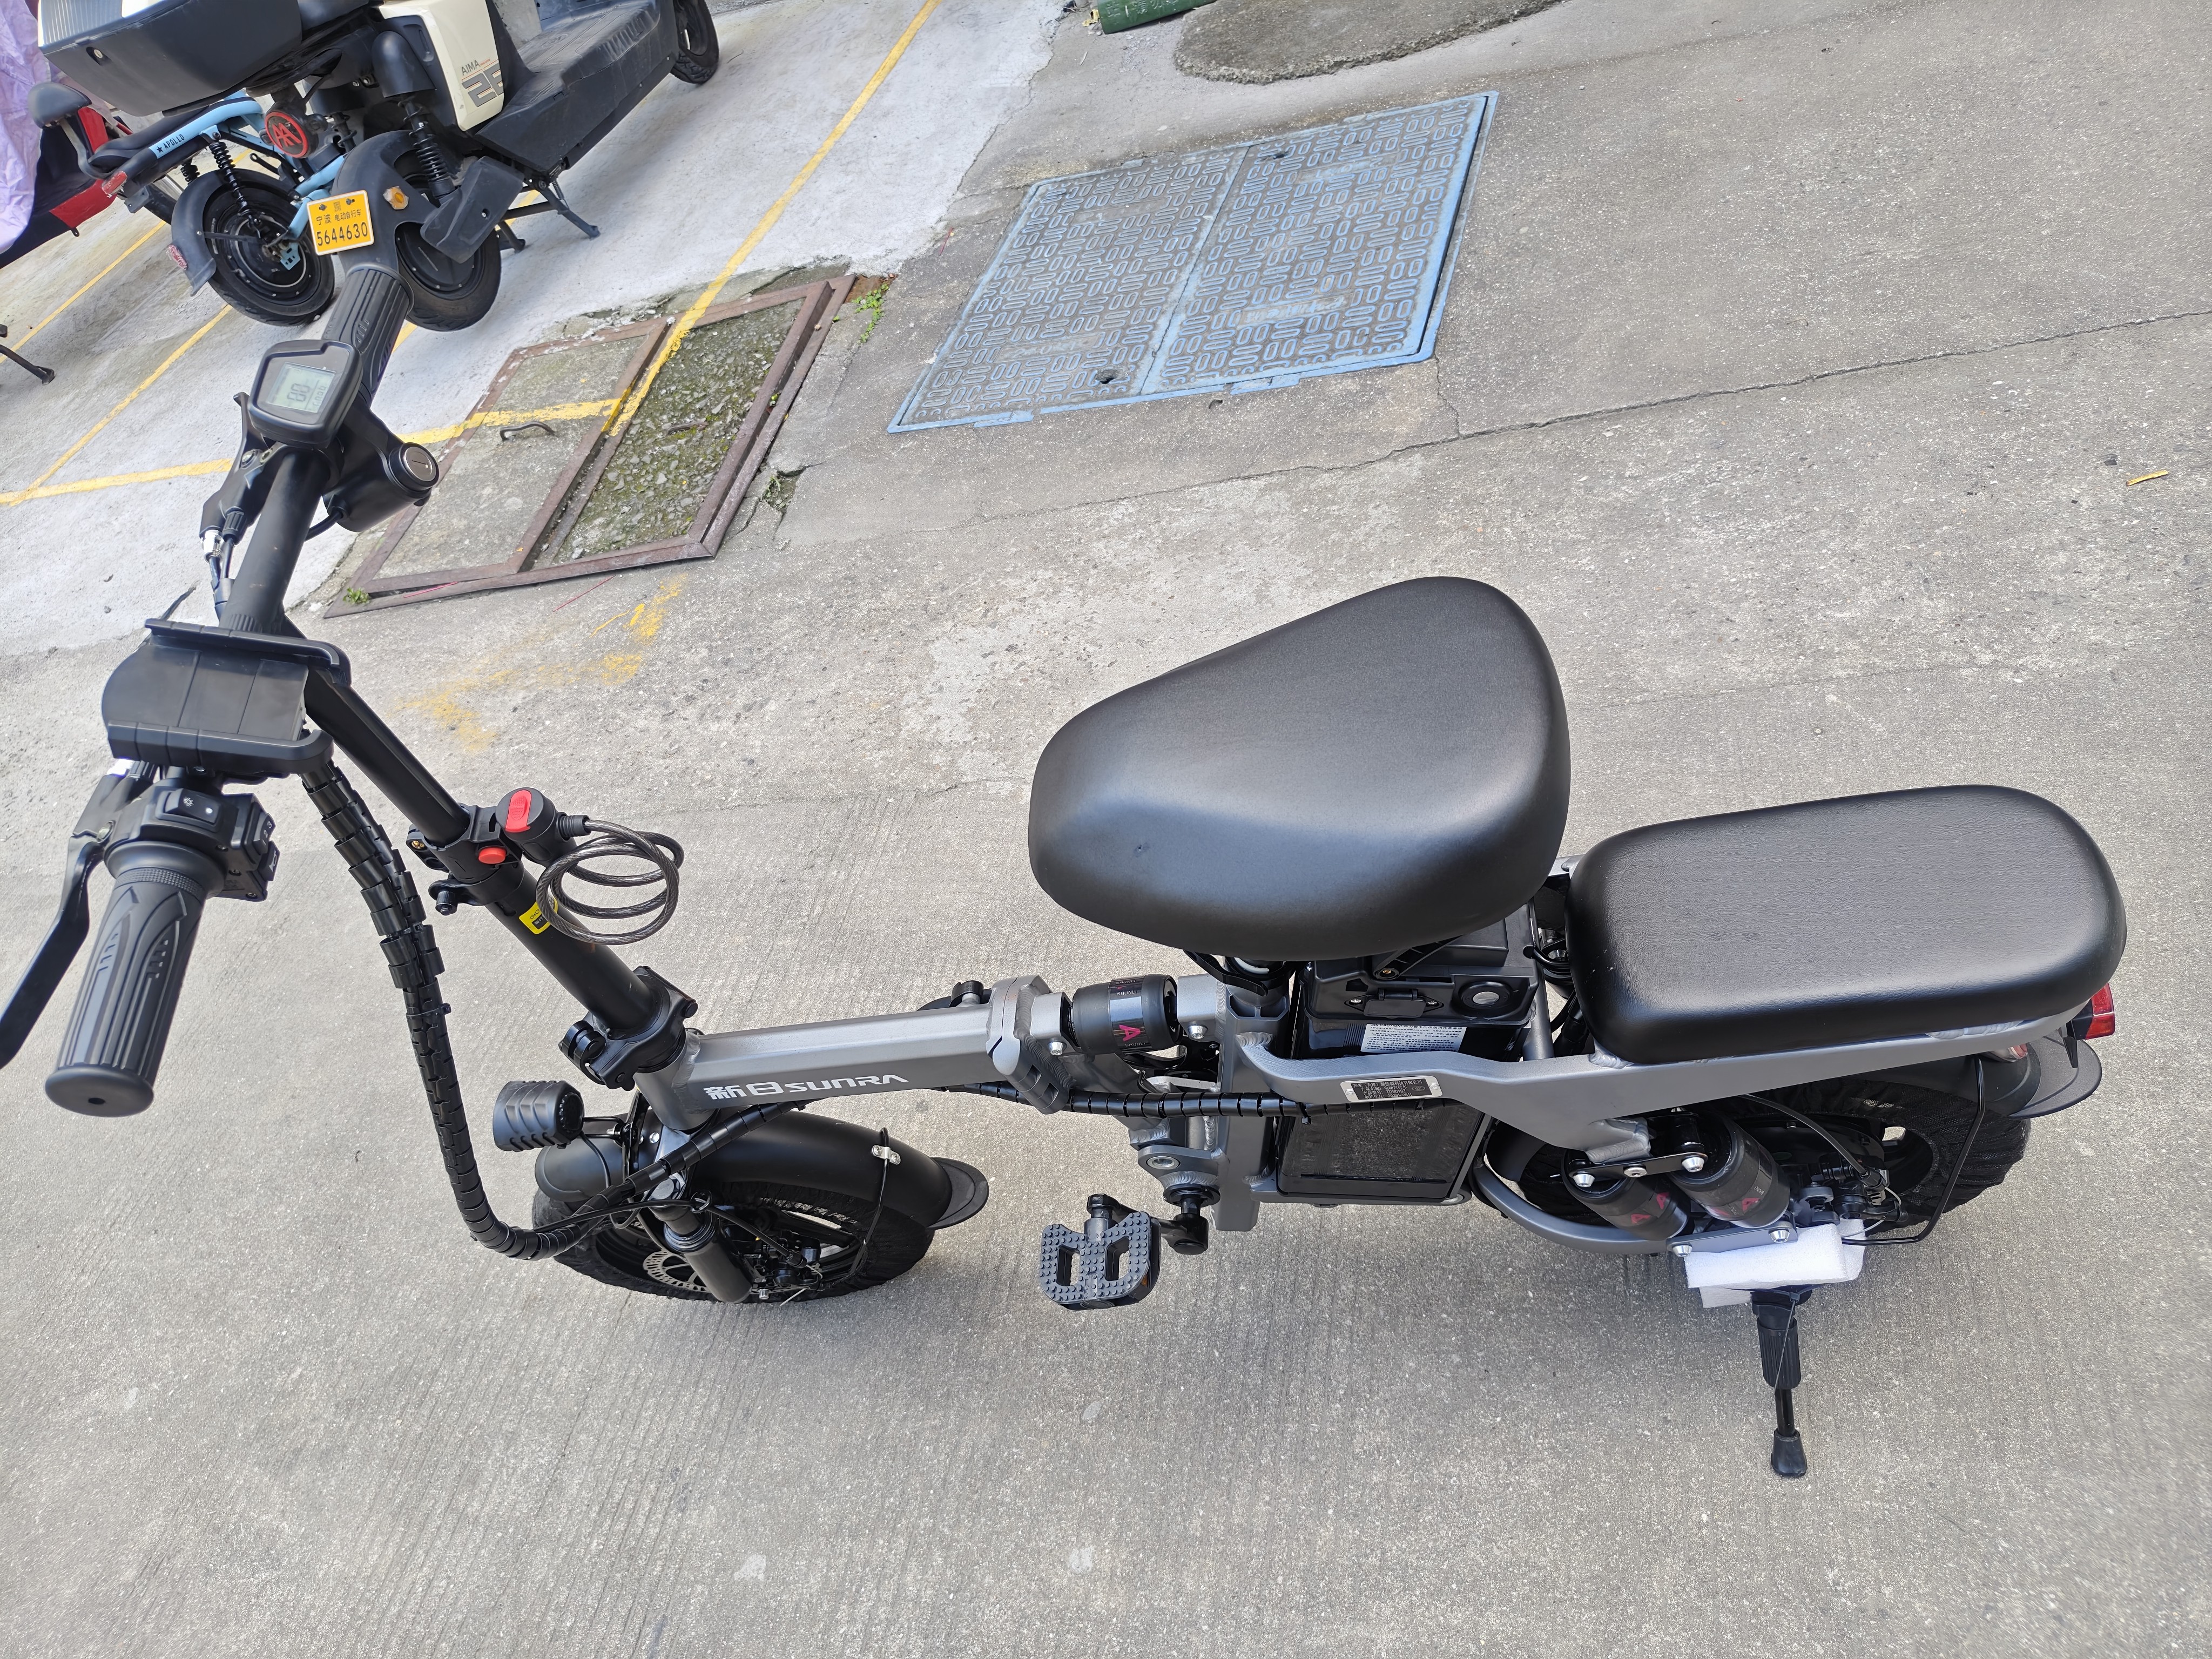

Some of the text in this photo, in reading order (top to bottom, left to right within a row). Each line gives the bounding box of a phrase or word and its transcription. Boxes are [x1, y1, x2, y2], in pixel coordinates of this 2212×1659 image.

[462, 59, 481, 76] AIMA
[163, 134, 185, 150] APOLLO
[316, 209, 361, 225] 宁波 电动自行车
[316, 222, 368, 246] 5644630
[703, 1082, 784, 1100] 新日
